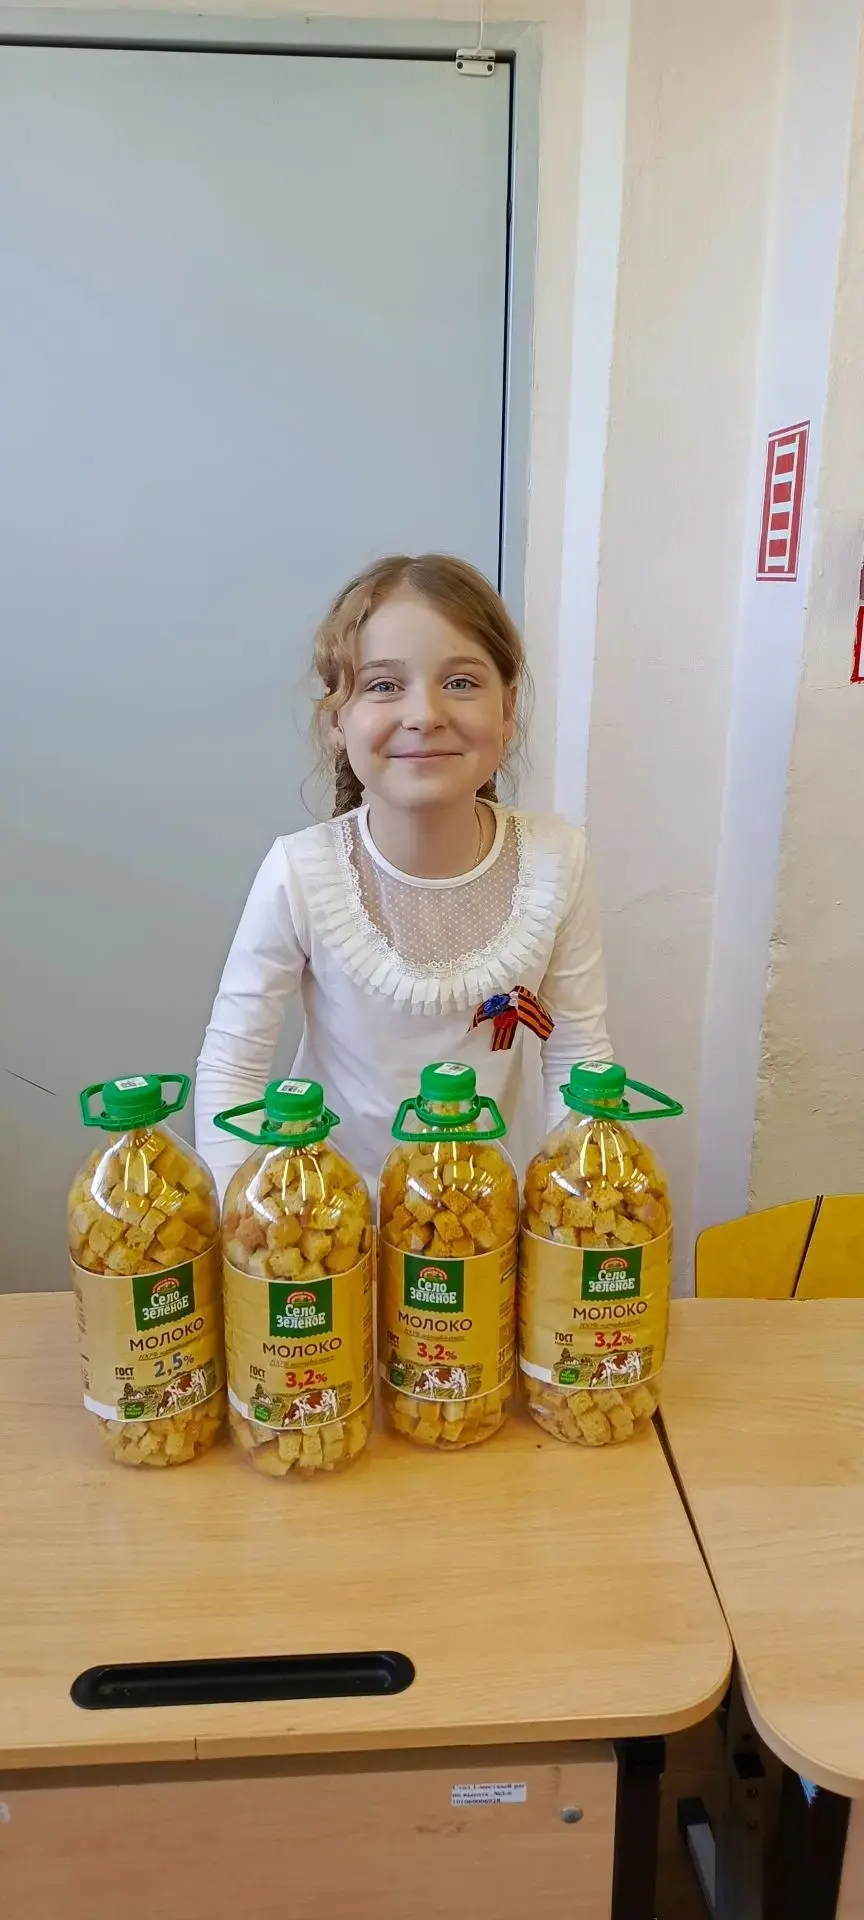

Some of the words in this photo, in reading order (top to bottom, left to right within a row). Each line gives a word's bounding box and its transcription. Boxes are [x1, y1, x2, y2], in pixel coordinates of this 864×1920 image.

[598, 1269, 626, 1281] Село
[417, 1278, 447, 1292] Село
[151, 1290, 180, 1308] Село
[285, 1304, 316, 1317] Село
[573, 1301, 648, 1320] МОЛОКО
[398, 1311, 473, 1332] МОЛОКО
[129, 1317, 204, 1351] МОЛОКО
[555, 1332, 573, 1342] ГОСТ
[594, 1330, 634, 1349] 3,2%
[262, 1337, 342, 1358] МОЛОКО
[417, 1342, 457, 1361] 3,2%
[115, 1367, 134, 1376] ГОСТ
[154, 1352, 194, 1378] 2,5%
[249, 1365, 265, 1378] ГОСТ
[285, 1369, 328, 1389] 3,2%
